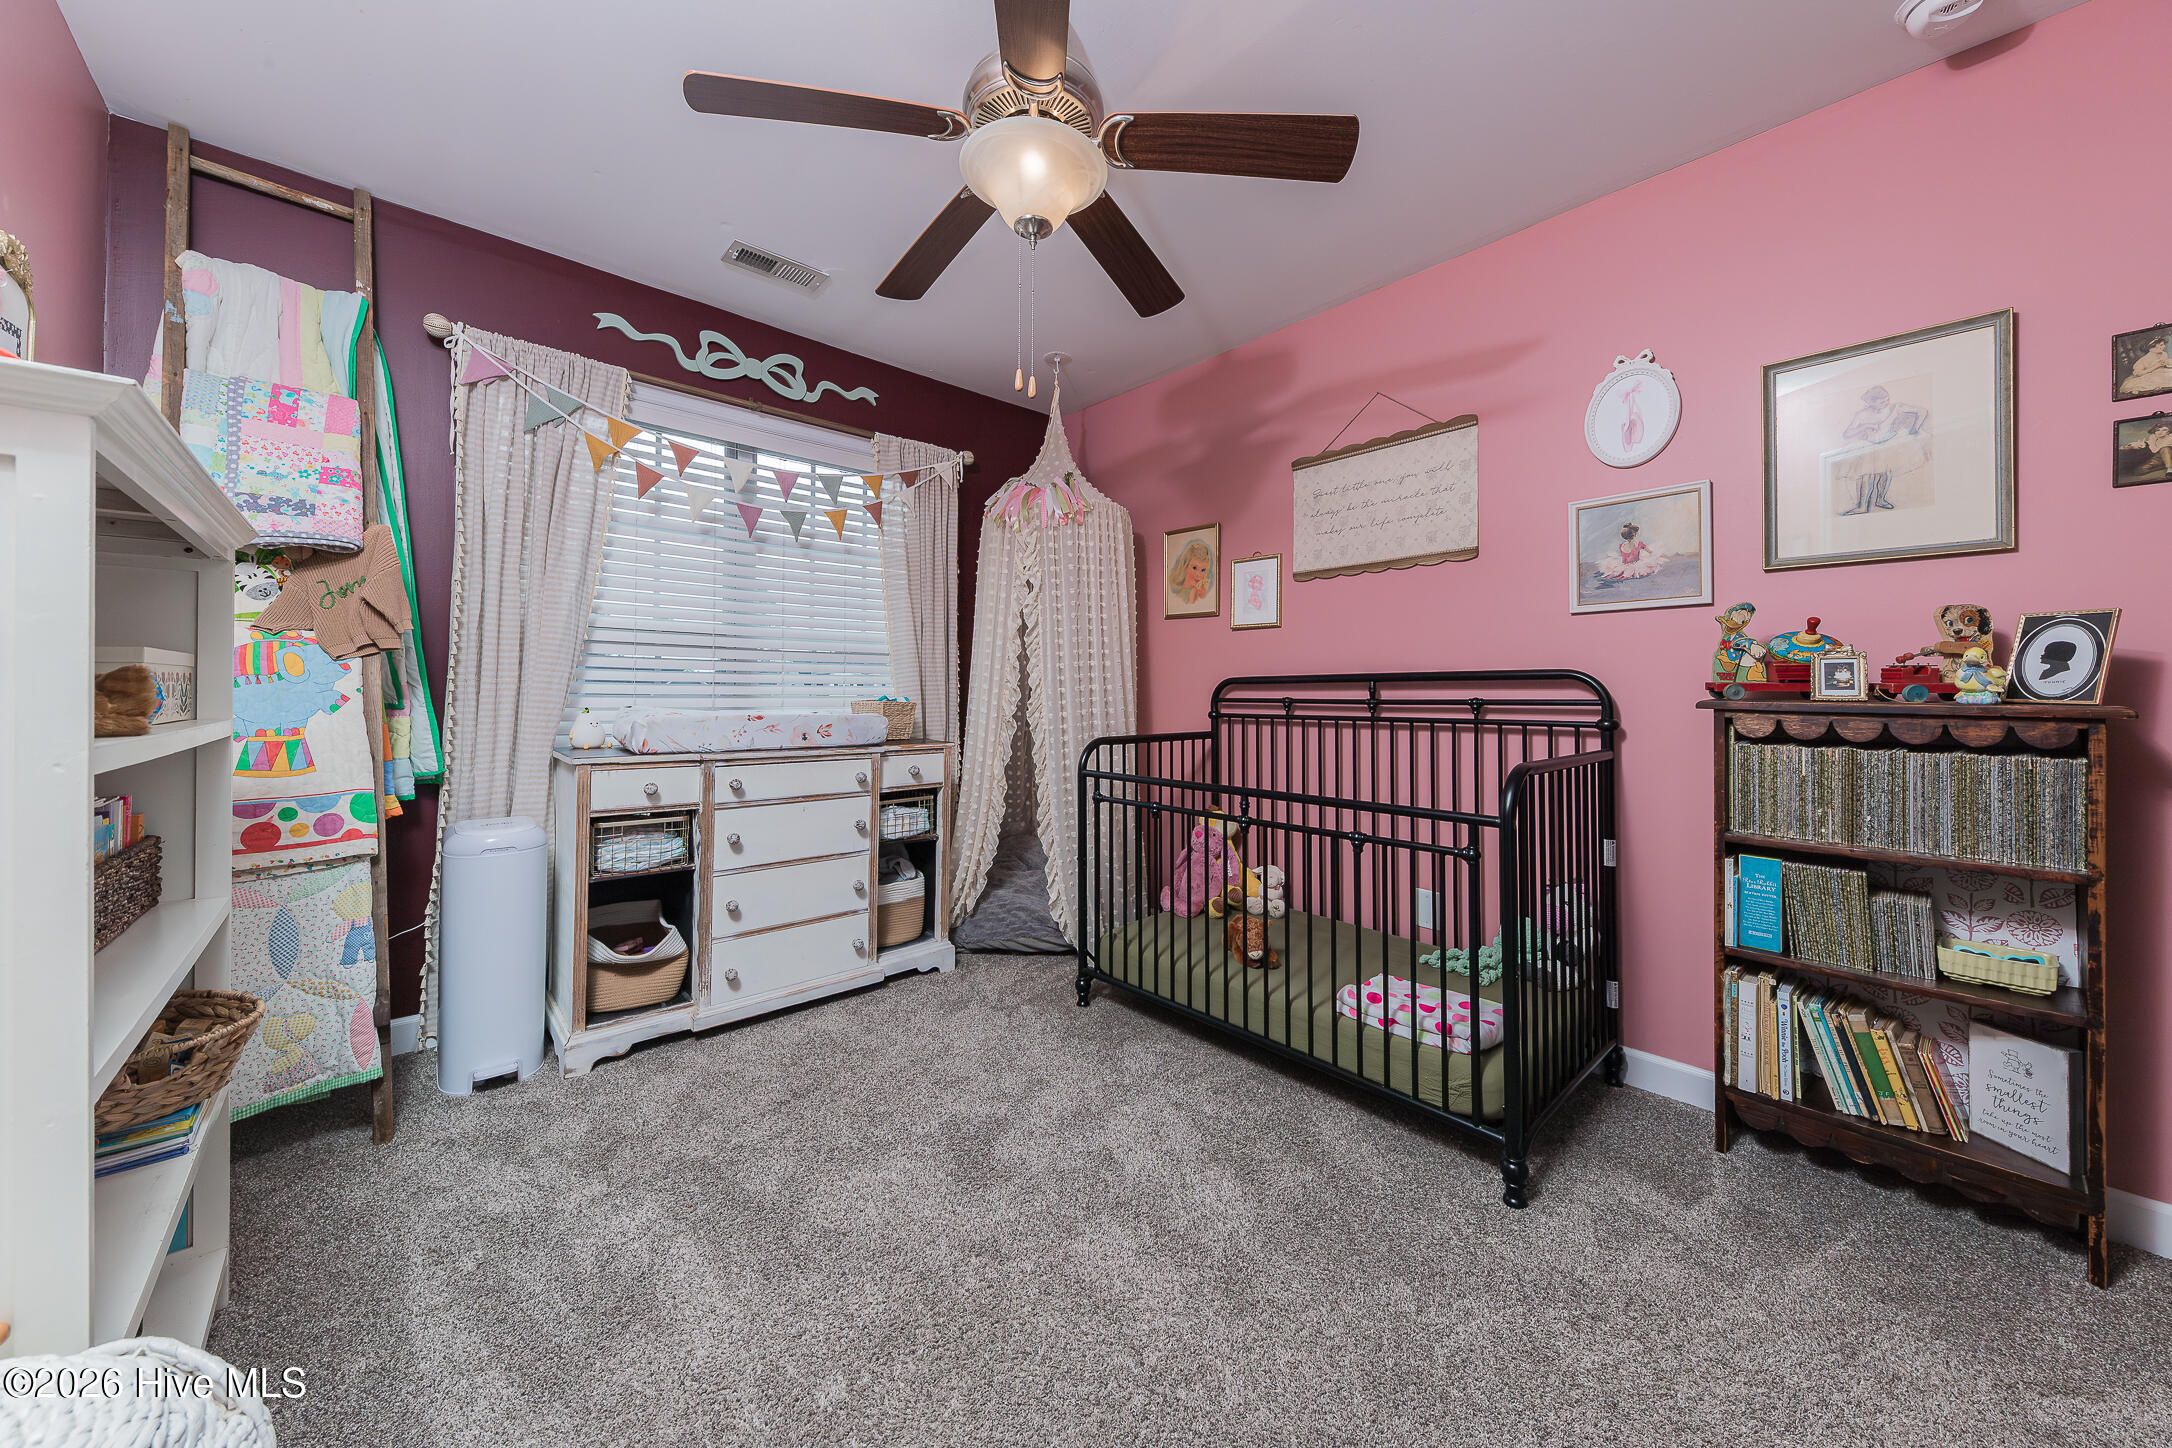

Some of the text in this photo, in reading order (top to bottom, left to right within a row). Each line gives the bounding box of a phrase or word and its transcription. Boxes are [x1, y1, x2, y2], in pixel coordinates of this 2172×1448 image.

[1342, 480, 1369, 493] little
[1399, 472, 1418, 485] you
[1424, 460, 1453, 474] will
[1310, 483, 1455, 520] always be the miracle that
[1315, 525, 1345, 536] makes
[1370, 513, 1394, 529] life
[1399, 507, 1448, 524] complete
[1746, 882, 1776, 892] LIBRARY
[1780, 1019, 1789, 1042] Winnie
[1781, 1048, 1789, 1063] Pooh
[1986, 1083, 2052, 1113] smallest
[1988, 1069, 2048, 1098] Sometimes the
[1992, 1095, 2045, 1125] things
[1978, 1118, 1997, 1128] room
[2009, 1130, 2030, 1143] your
[2032, 1138, 2061, 1155] heart
[1982, 1108, 2055, 1143] take up the most
